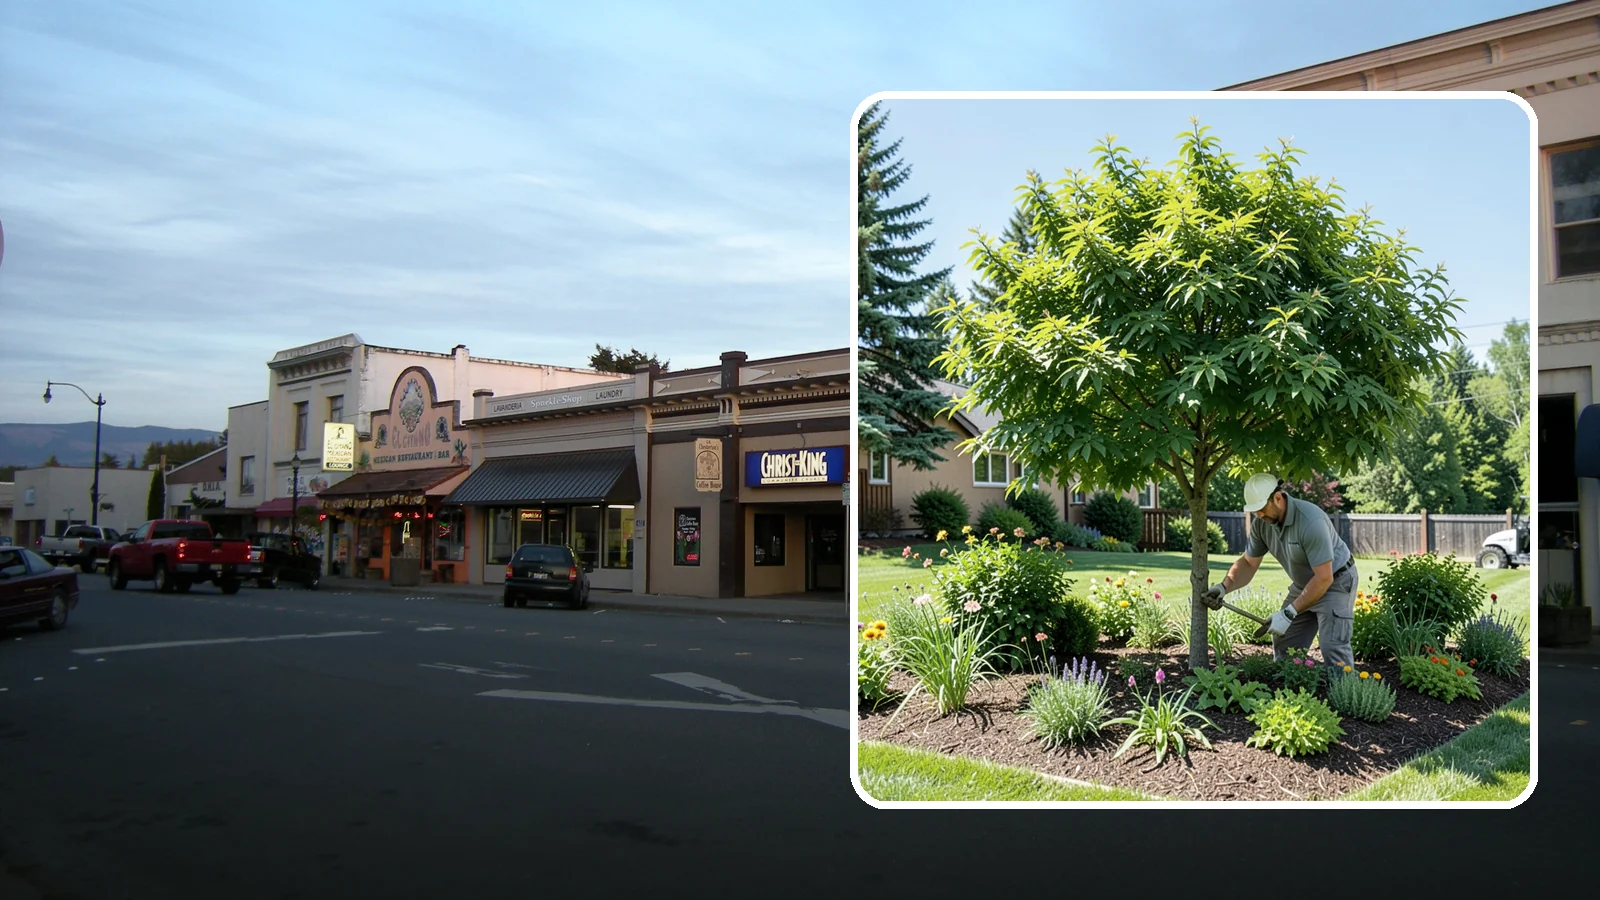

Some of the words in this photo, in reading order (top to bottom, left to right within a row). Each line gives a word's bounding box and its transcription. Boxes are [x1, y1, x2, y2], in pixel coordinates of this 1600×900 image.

[493, 402, 523, 413] LAVANDERIA
[560, 394, 582, 404] Shop
[595, 389, 624, 400] LAUNDRY
[373, 455, 396, 464] MEXICAN
[397, 451, 433, 462] RESTAURANT
[437, 450, 450, 458] BAR
[761, 452, 797, 478] CHRIST
[799, 450, 827, 476] KING
